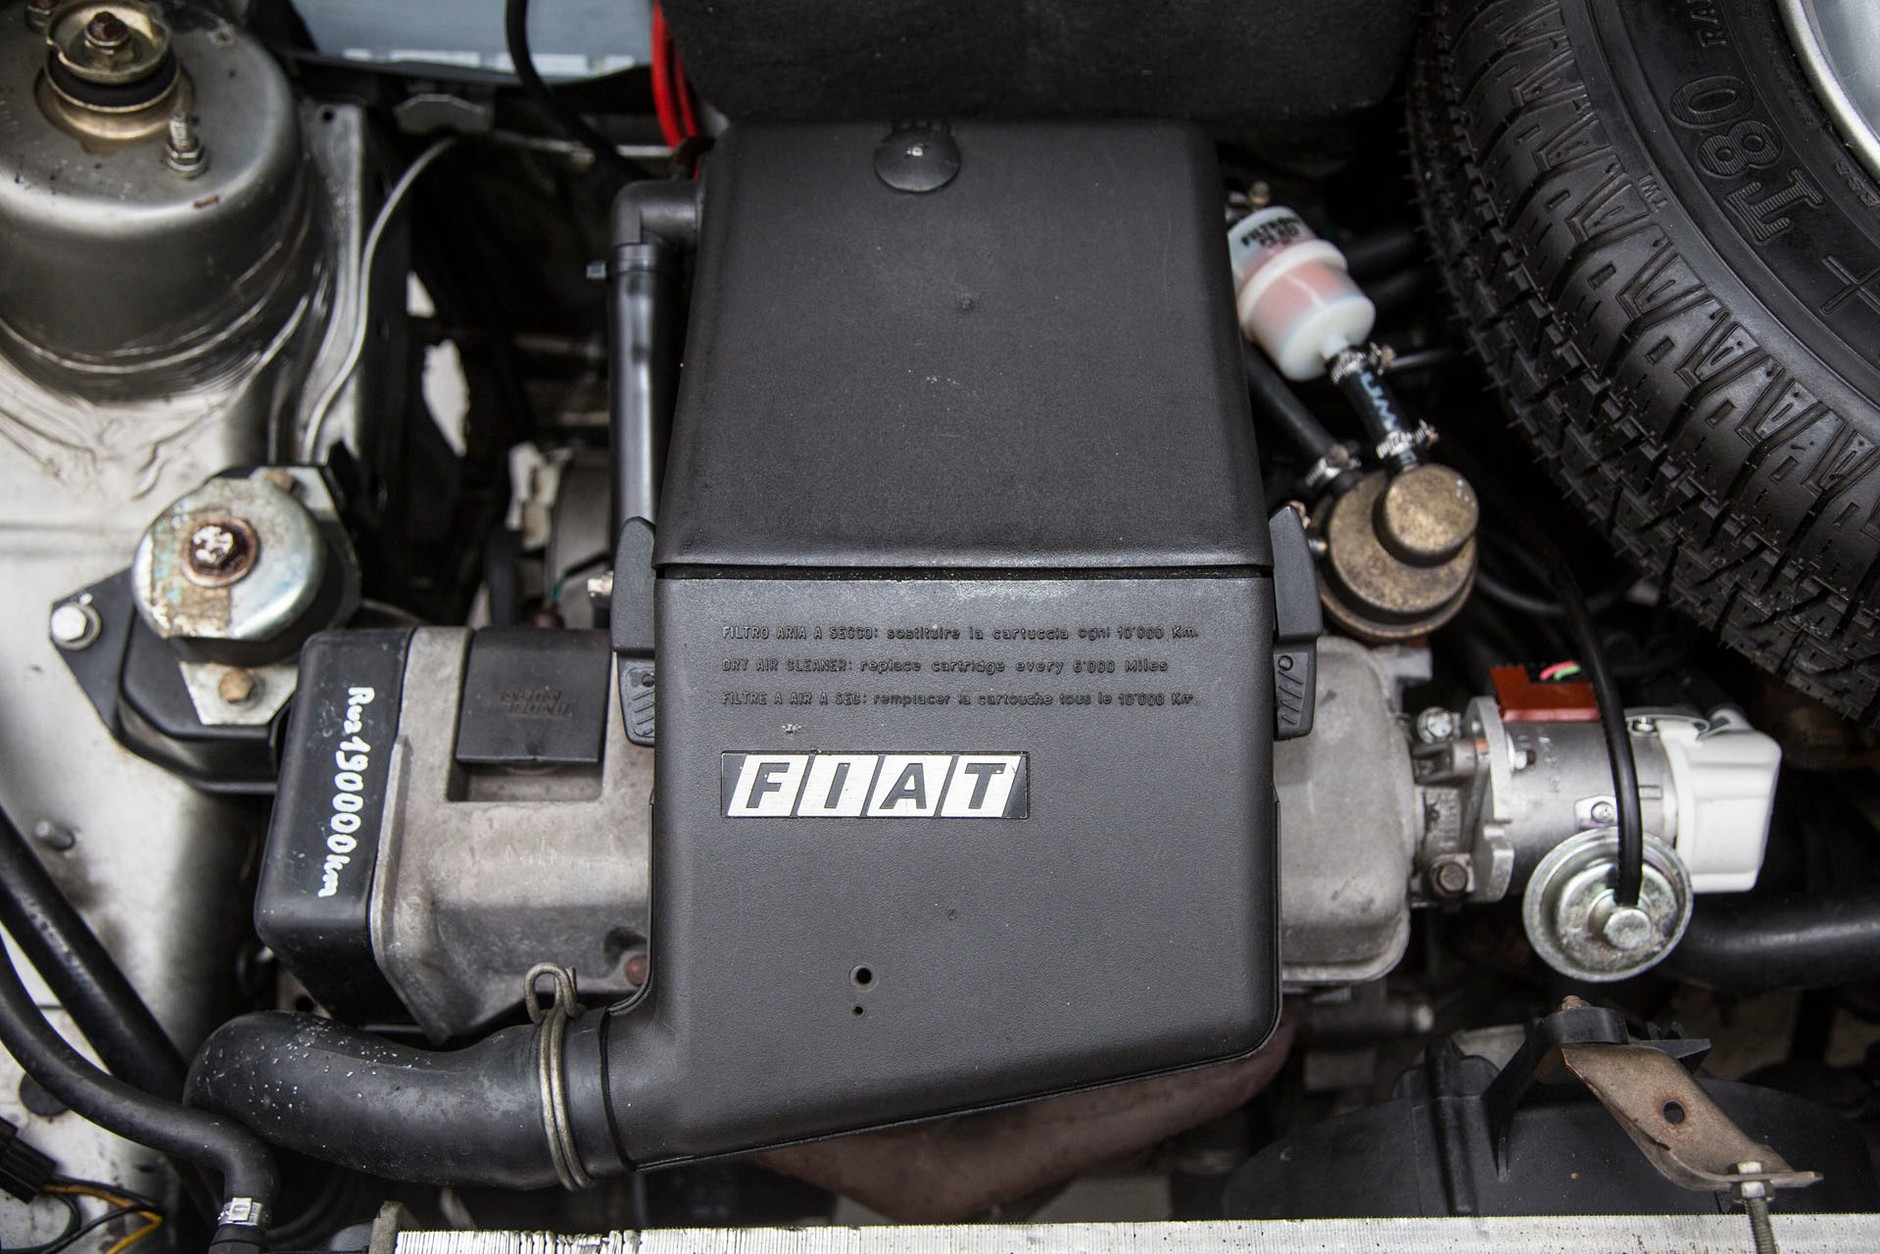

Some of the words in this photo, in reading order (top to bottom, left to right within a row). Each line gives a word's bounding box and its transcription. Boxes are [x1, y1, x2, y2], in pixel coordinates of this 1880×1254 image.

[1686, 0, 1727, 48] RA
[722, 626, 770, 640] FILTRO
[776, 626, 807, 640] ARIA
[813, 626, 823, 640] A
[829, 626, 879, 641] SECCO:
[886, 626, 961, 641] sostituire
[968, 626, 984, 641] la
[991, 626, 1070, 641] cartuccia
[1077, 626, 1111, 642] ogni
[721, 658, 749, 672] DRY
[755, 658, 779, 672] AIR
[786, 658, 853, 673] CLEANER:
[860, 659, 922, 675] replace
[930, 659, 1005, 676] cartridge
[1015, 661, 1065, 675] every
[1124, 658, 1168, 673] Miles
[721, 691, 767, 706] FILTRE
[773, 692, 784, 706] A
[789, 692, 813, 706] AIR
[819, 692, 829, 706] A
[834, 692, 868, 706] SEC:
[872, 693, 951, 708] remplacer
[977, 692, 1054, 706] cartouche
[1059, 692, 1093, 706] tous
[743, 760, 1009, 811] FIAT
